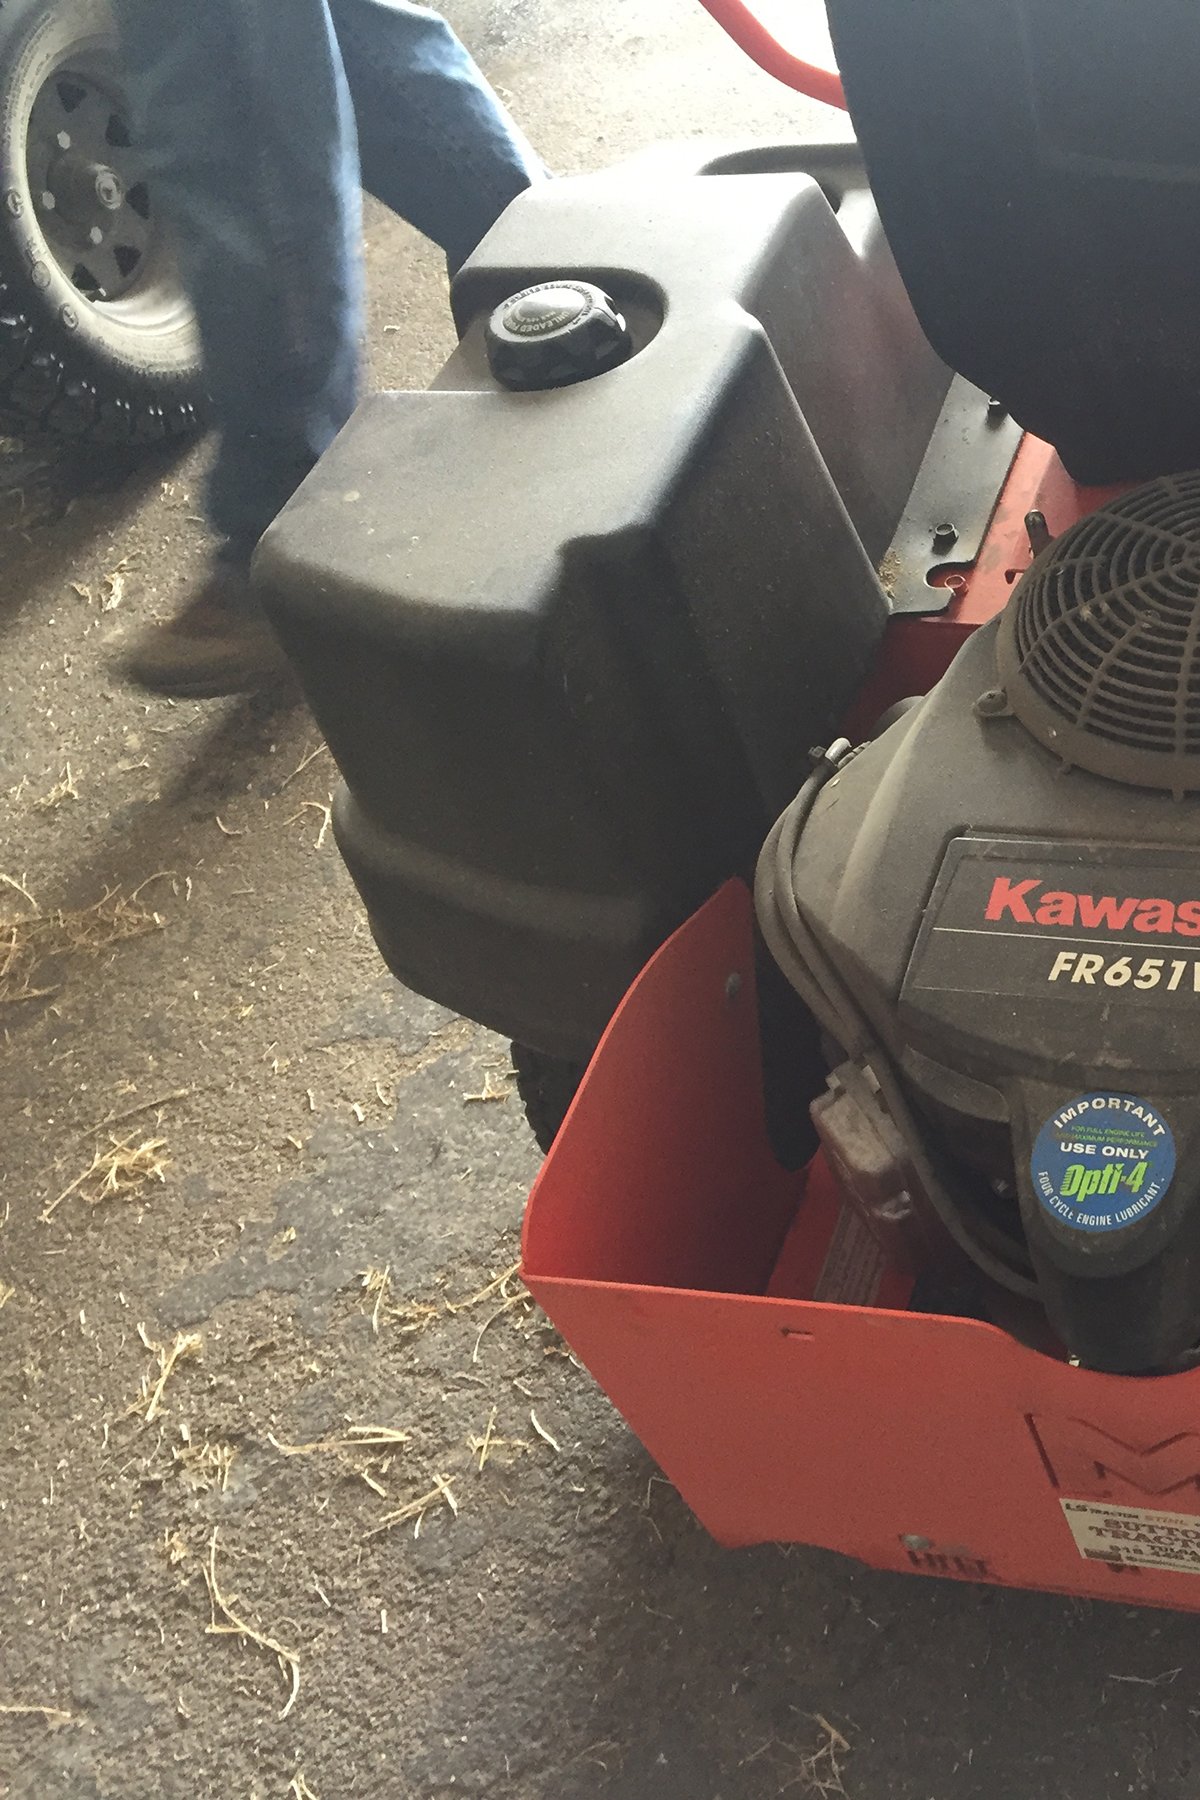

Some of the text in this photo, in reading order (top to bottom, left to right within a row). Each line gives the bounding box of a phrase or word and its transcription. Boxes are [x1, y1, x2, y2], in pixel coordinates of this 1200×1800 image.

[520, 311, 569, 332] UNLEADED
[1053, 1097, 1165, 1137] IMPORTANT
[1060, 1142, 1149, 1160] USE ONLY
[1038, 1171, 1054, 1196] FOUR
[1049, 1195, 1074, 1220] CYCLE
[1076, 1213, 1112, 1226] ENGINE
[1060, 1161, 1148, 1202] Opti-4
